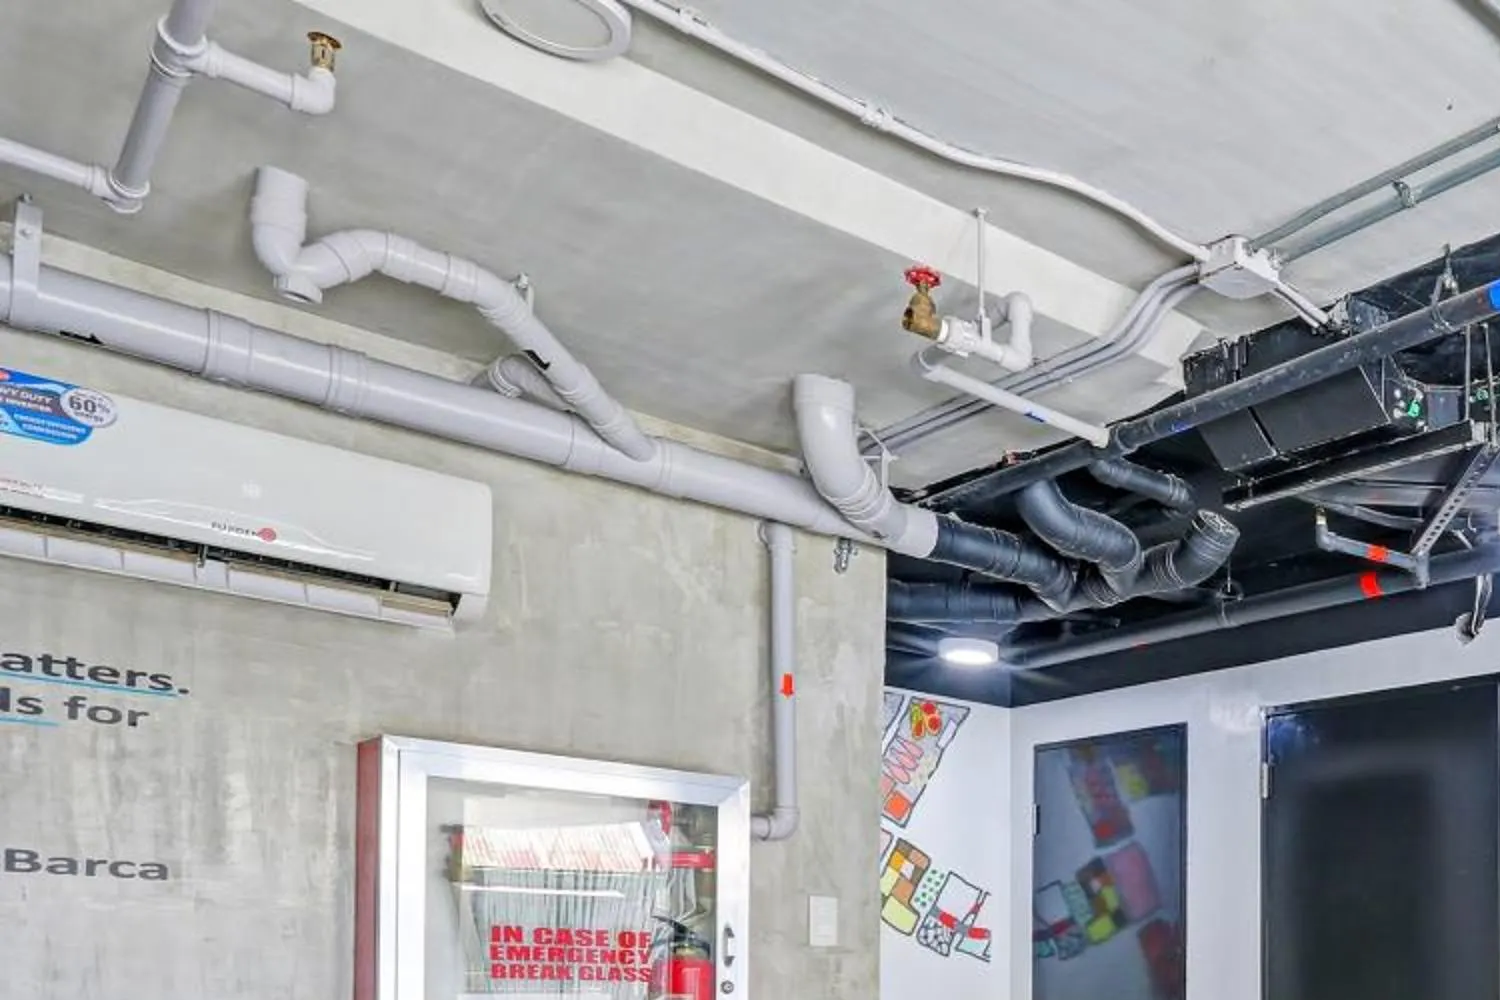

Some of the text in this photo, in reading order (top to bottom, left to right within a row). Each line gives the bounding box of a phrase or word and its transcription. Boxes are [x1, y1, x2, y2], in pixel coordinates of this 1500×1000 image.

[64, 695, 149, 726] for
[4, 848, 169, 880] Barca
[490, 925, 653, 948] IN CASE OF
[489, 944, 652, 964] EMERGENCY
[490, 963, 653, 983] BREAK GLASS
